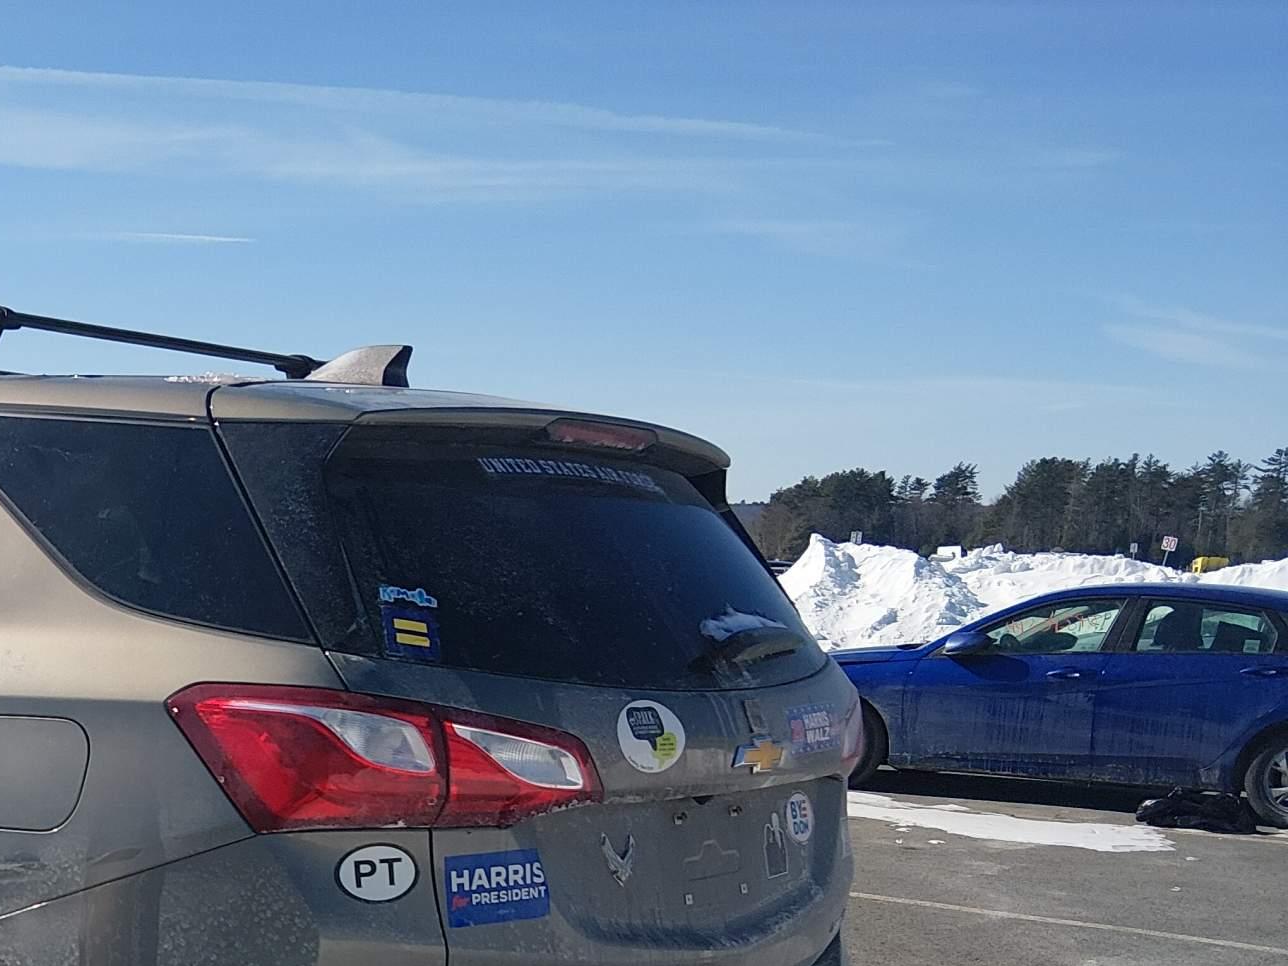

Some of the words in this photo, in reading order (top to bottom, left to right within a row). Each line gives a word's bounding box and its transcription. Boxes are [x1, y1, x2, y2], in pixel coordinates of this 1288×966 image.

[477, 457, 542, 474] UNITED
[538, 459, 598, 478] STATES
[1163, 537, 1177, 549] 30
[802, 711, 830, 730] HARRIS
[806, 727, 831, 743] WALZ
[790, 799, 808, 820] BYE
[793, 819, 809, 836] DON
[353, 857, 403, 889] PT
[450, 862, 545, 893] HARRIS
[472, 886, 546, 906] PRESIDENT
